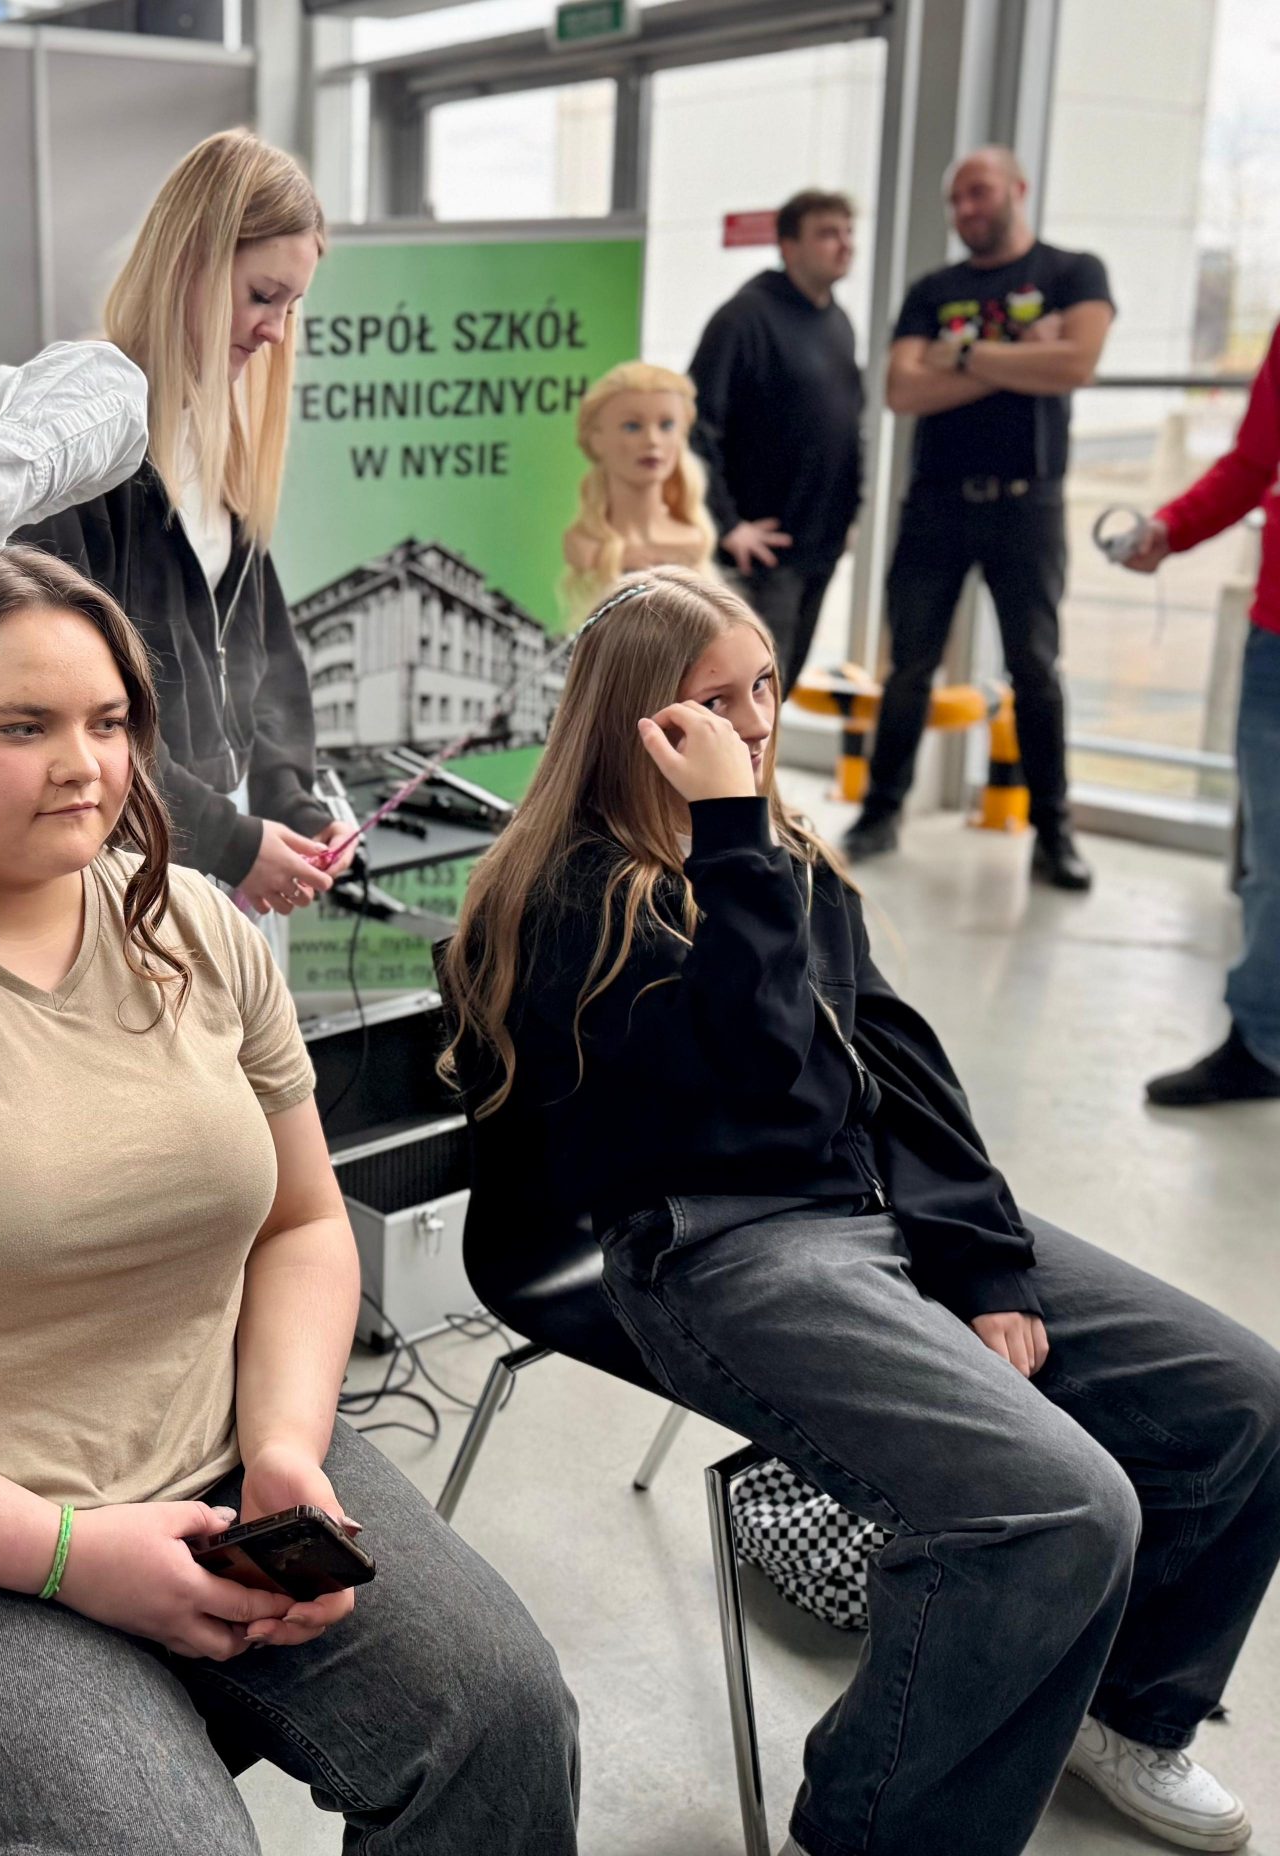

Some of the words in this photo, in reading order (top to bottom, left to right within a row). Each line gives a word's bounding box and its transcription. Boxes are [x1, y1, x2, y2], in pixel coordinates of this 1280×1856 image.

[297, 302, 437, 356] ESPÓŁ
[453, 296, 587, 351] SZKÓŁ
[293, 375, 588, 421] ECHNICZNYCH
[350, 445, 388, 479] W
[400, 441, 510, 477] NYSIE
